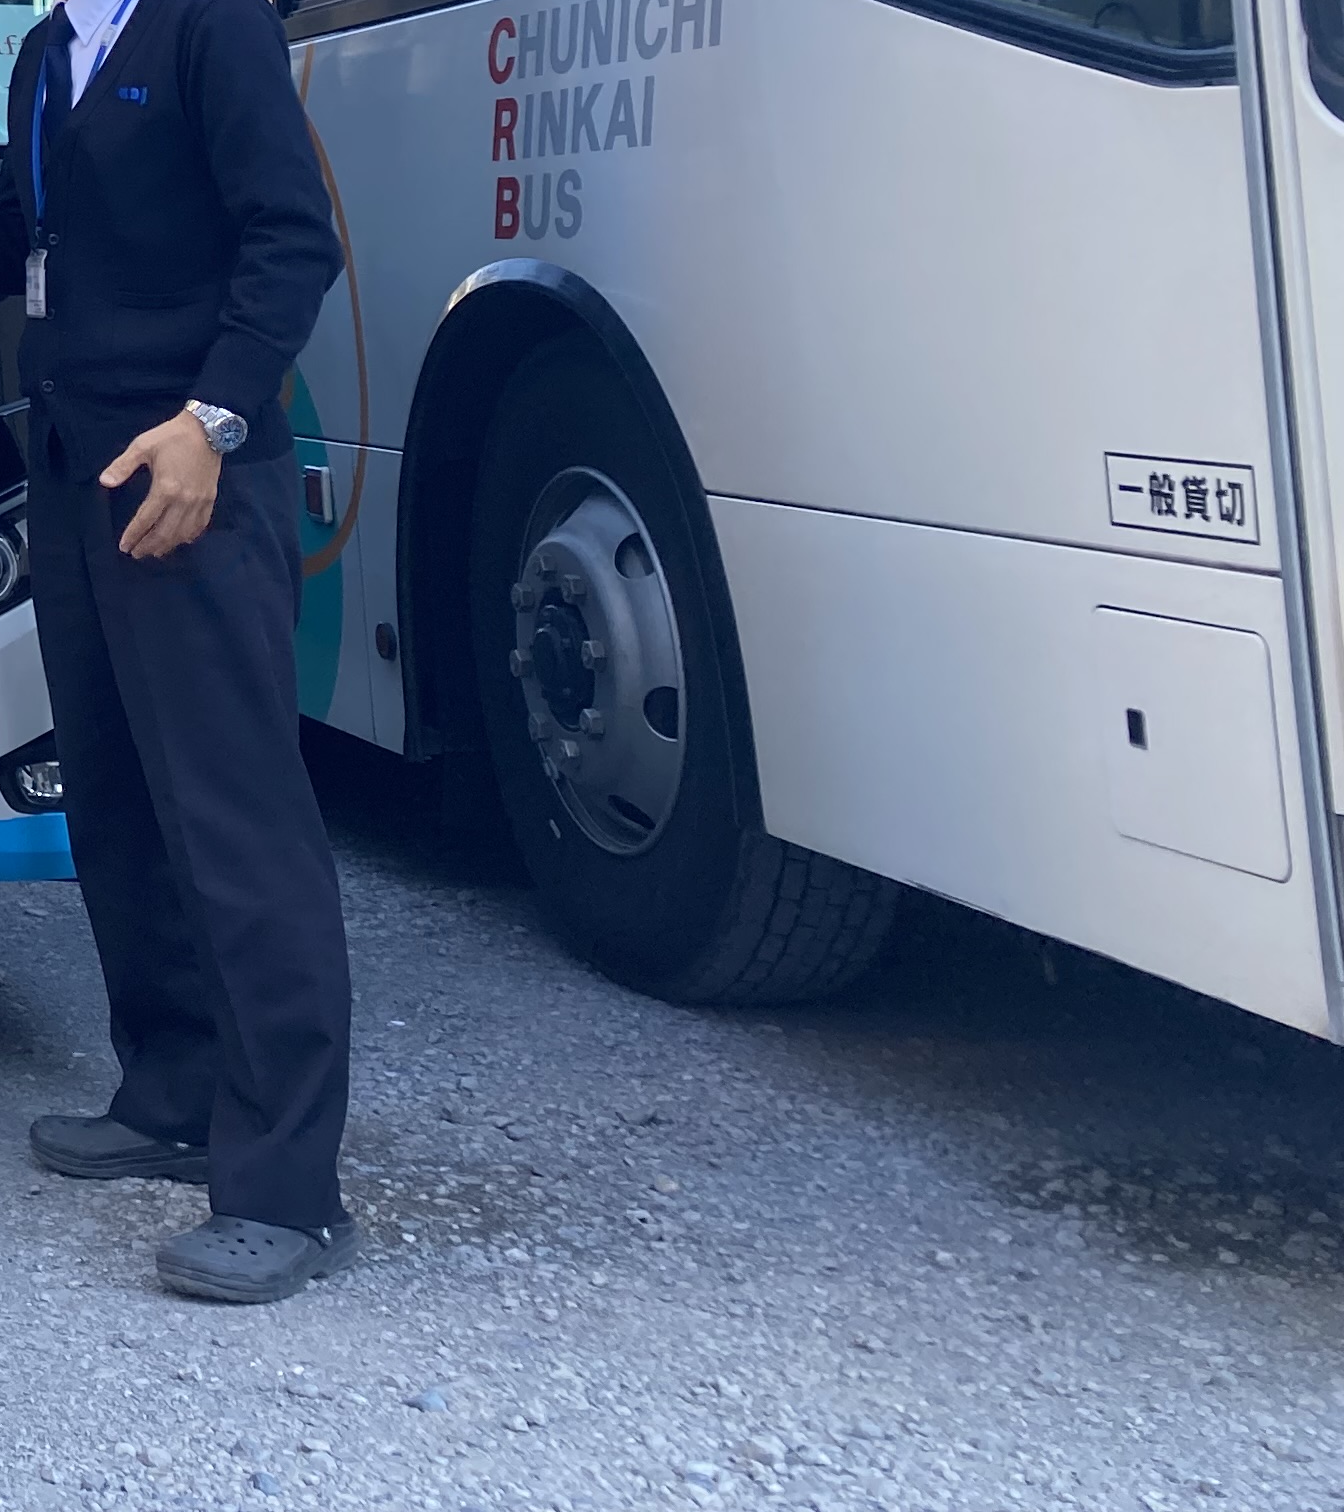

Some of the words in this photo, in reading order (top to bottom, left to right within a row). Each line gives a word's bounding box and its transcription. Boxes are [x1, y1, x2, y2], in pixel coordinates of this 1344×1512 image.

[492, 75, 655, 161] RINKAI
[494, 168, 583, 240] BUS
[1118, 471, 1245, 527] 一般貸切
